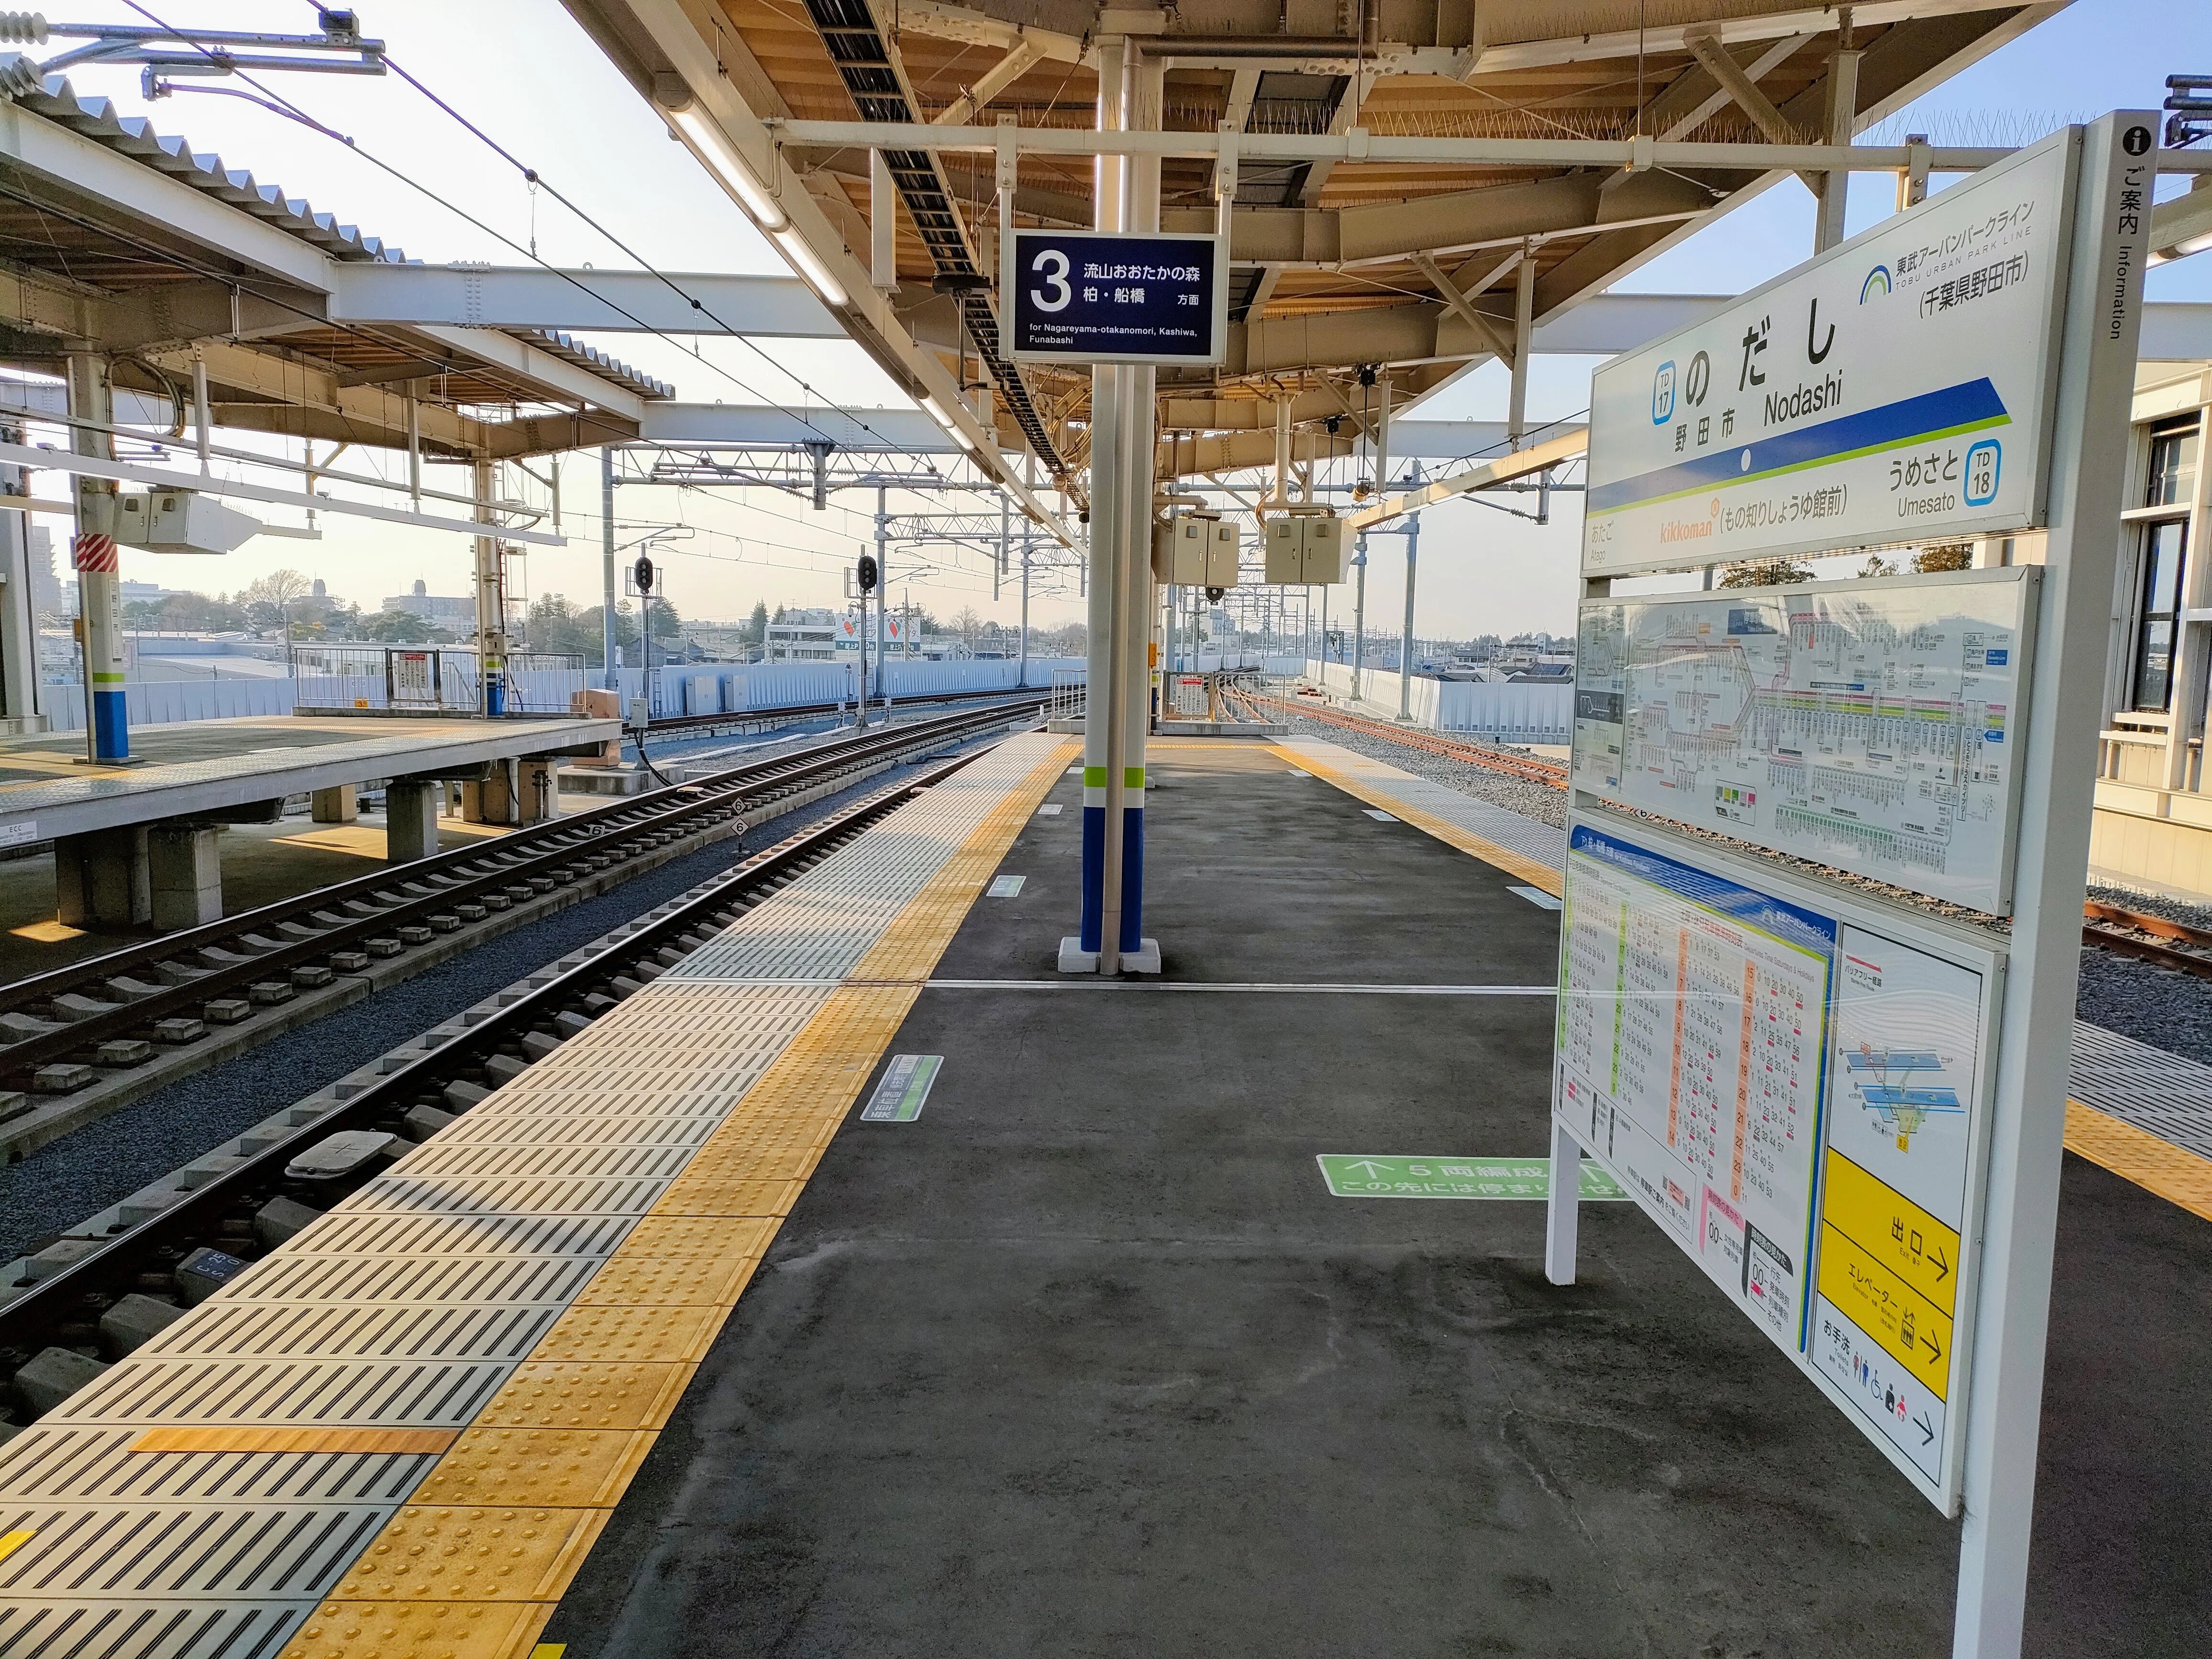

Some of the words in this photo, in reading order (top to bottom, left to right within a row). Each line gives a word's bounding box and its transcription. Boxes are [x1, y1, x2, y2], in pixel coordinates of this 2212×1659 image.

[2119, 166, 2145, 235] ご案内
[1896, 201, 2035, 277] 東武アーバンパークライン
[1084, 263, 1200, 282] 流山おおたかの森
[1896, 274, 1920, 290] TOBU
[1926, 257, 1961, 277] URBAN
[1968, 241, 1996, 260] PARK
[2003, 226, 2032, 245] LINE
[1030, 249, 1072, 312] 3
[1084, 287, 1145, 304] 柏・船橋
[1177, 294, 1199, 306] 方面
[1920, 250, 2028, 319] (千葉県野田市)
[2110, 246, 2133, 341] Information
[1029, 323, 1041, 332] for
[1044, 323, 1156, 336] Nagareyama-otakanomori,
[1159, 328, 1197, 337] Kashiwa,
[1029, 335, 1073, 344] Funabashi
[1685, 298, 1835, 407] のだし
[1660, 373, 1670, 388] TD
[1764, 369, 1843, 427] Nodashi
[1659, 391, 1669, 413] 17
[1675, 408, 1735, 453] 野田市
[1890, 449, 1958, 491] うめさと
[1976, 452, 1990, 467] TD
[1974, 471, 1990, 495] 18
[1720, 484, 1847, 534] (もの知りしょうゆ館前)
[1898, 492, 1955, 517] Umesato
[1591, 519, 1614, 544] あたご
[1660, 520, 1713, 543] kikkoman
[1590, 549, 1606, 564] Atago
[1746, 966, 1753, 979] 15
[1757, 972, 1760, 983] 0
[1764, 976, 1770, 986] 10
[1771, 980, 1778, 991] 20
[1779, 984, 1786, 995] 30
[1788, 987, 1794, 999] 40
[1796, 992, 1803, 1003] 50
[1743, 1015, 1750, 1028] 17
[1754, 1022, 1758, 1032] 2
[1760, 1026, 1767, 1037] 11
[1768, 1030, 1775, 1041] 25
[1776, 1034, 1782, 1046] 35
[1784, 1039, 1791, 1051] 47
[1792, 1043, 1800, 1056] 56
[1741, 1039, 1748, 1052] 18
[1752, 1046, 1756, 1057] 2
[1759, 1051, 1765, 1062] 10
[1767, 1055, 1773, 1067] 20
[1774, 1060, 1781, 1072] 33
[1782, 1064, 1789, 1077] 41
[1791, 1070, 1798, 1082] 51
[1740, 1063, 1747, 1076] 19
[1751, 1071, 1754, 1081] 1
[1757, 1075, 1763, 1087] 11
[1765, 1080, 1771, 1092] 21
[1772, 1085, 1779, 1097] 31
[1781, 1090, 1787, 1102] 41
[1789, 1095, 1796, 1108] 51
[1738, 1087, 1746, 1101] 20
[1749, 1095, 1753, 1106] 1
[1756, 1100, 1762, 1112] 11
[1763, 1105, 1770, 1117] 23
[1771, 1110, 1777, 1123] 32
[1779, 1116, 1786, 1128] 41
[1787, 1121, 1794, 1134] 52
[1737, 1111, 1744, 1125] 21
[1747, 1119, 1751, 1130] 6
[1754, 1125, 1760, 1137] 22
[1761, 1130, 1768, 1142] 32
[1769, 1135, 1776, 1148] 44
[1777, 1141, 1784, 1154] 57
[1736, 1135, 1742, 1149] 22
[1745, 1144, 1750, 1155] 11
[1752, 1150, 1759, 1161] 25
[1760, 1155, 1766, 1167] 40
[1768, 1161, 1774, 1173] 55
[1734, 1159, 1741, 1173] 23
[1743, 1168, 1749, 1180] 10
[1751, 1174, 1757, 1186] 23
[1759, 1180, 1765, 1192] 40
[1766, 1186, 1772, 1198] 53
[1734, 1183, 1738, 1197] 0
[1742, 1192, 1747, 1204] 11
[1751, 1227, 1787, 1267] 時刻表の見かた
[1891, 1216, 1922, 1256] 出口
[1900, 1247, 1909, 1260] Exit
[1752, 1262, 1763, 1287] 00
[1770, 1266, 1781, 1284] 行先
[1848, 1263, 1898, 1308] エレベーター
[1768, 1295, 1788, 1323] 列車種別
[1769, 1281, 1789, 1308] 発車時刻
[1824, 1319, 1850, 1355] お手洗
[1835, 1348, 1848, 1366] Toilets
